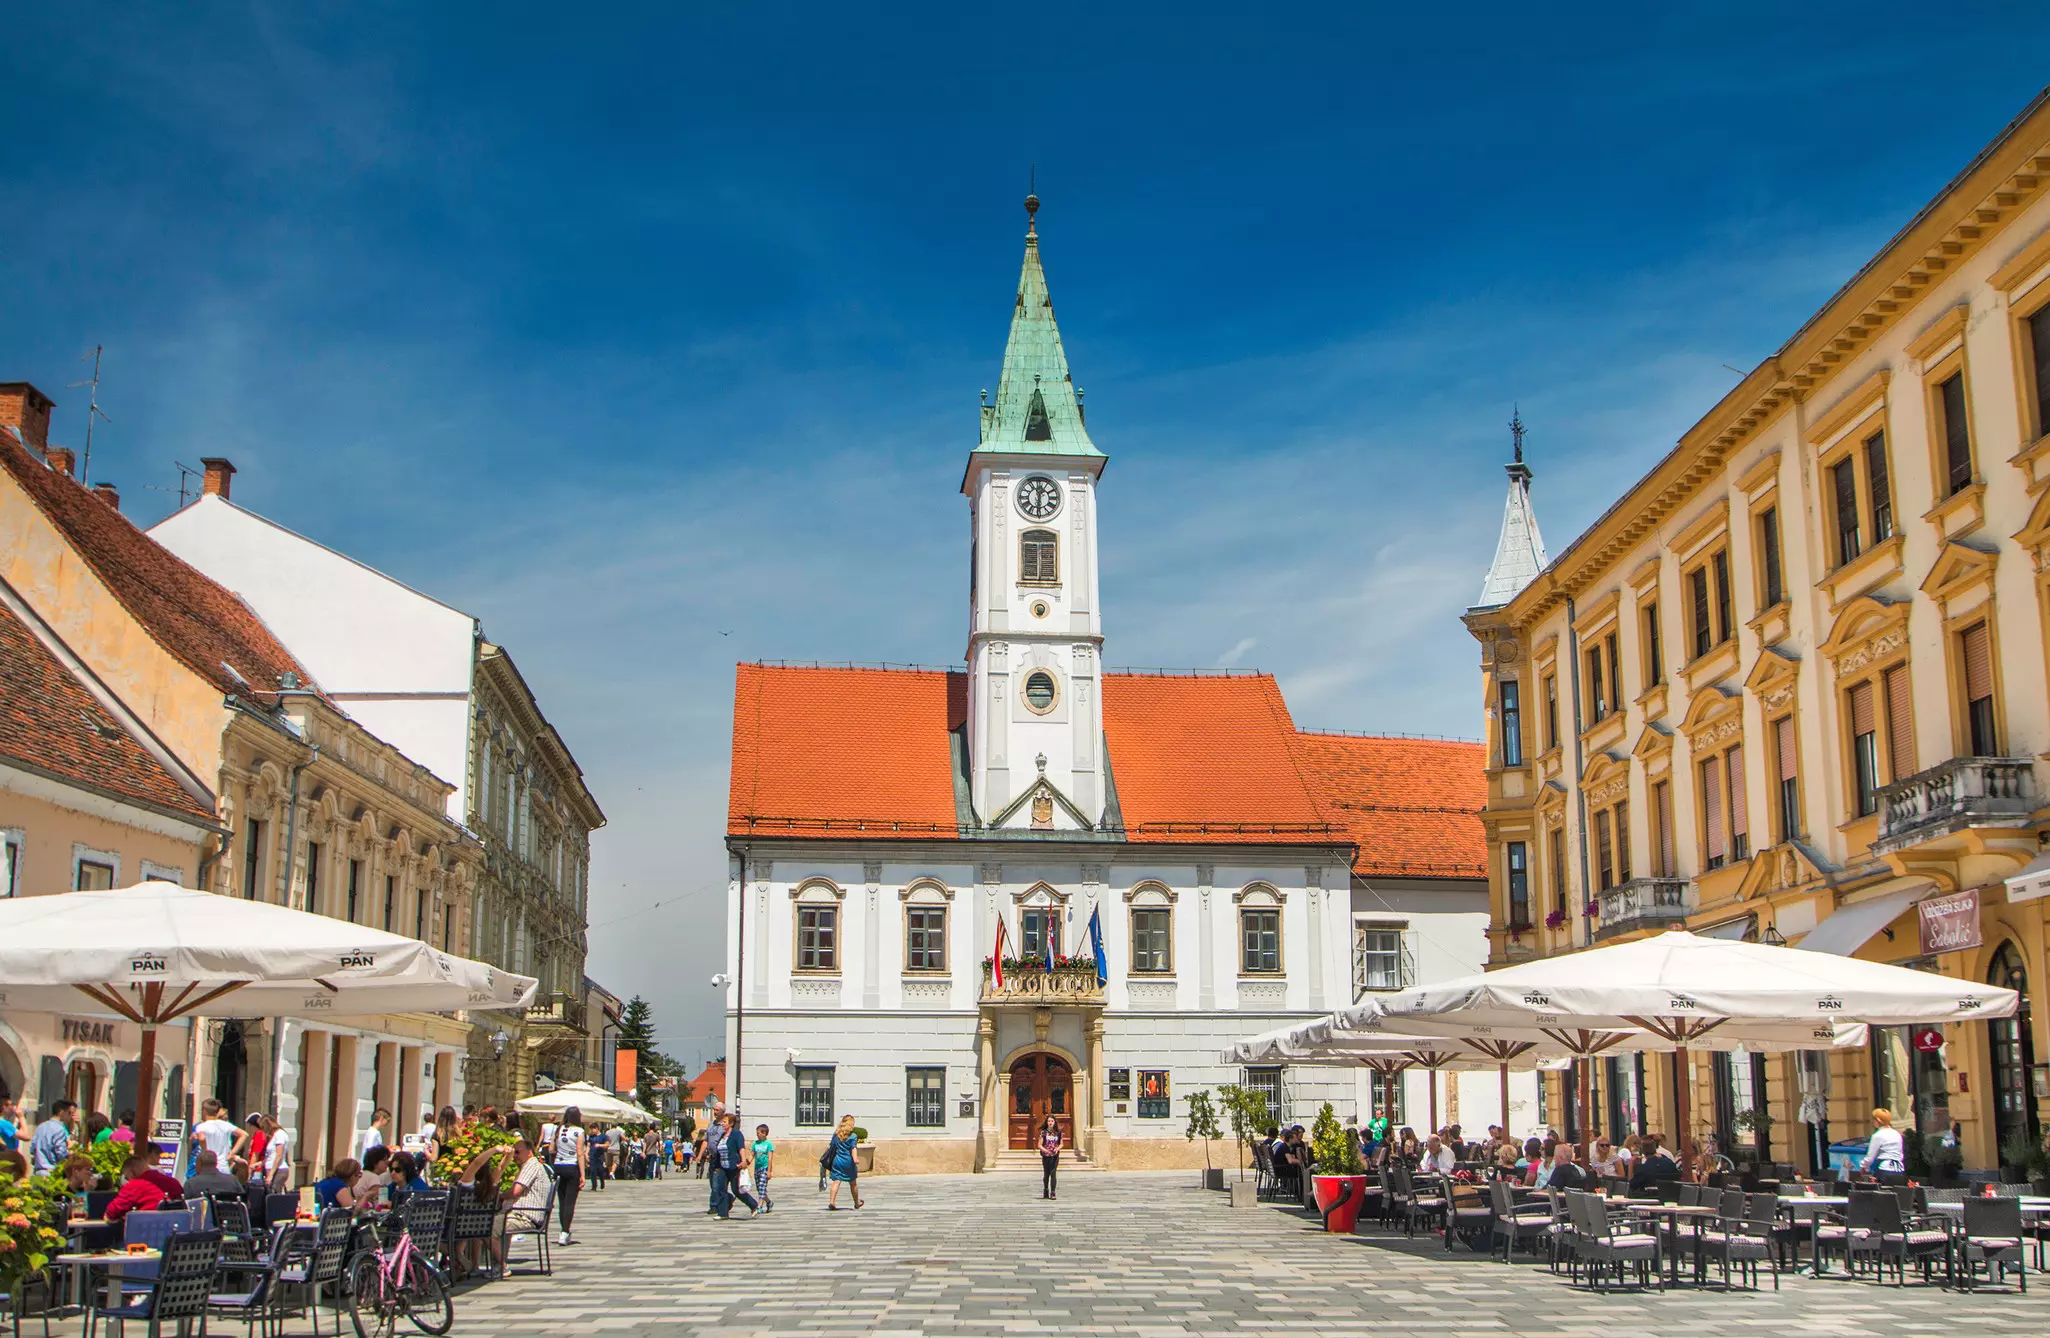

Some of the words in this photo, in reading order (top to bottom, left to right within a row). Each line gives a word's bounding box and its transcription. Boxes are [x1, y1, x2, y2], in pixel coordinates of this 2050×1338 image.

[340, 956, 375, 967] PAN
[132, 961, 166, 972] PAN
[1524, 996, 1549, 1005] PAN
[1671, 1000, 1695, 1009] PAN
[1818, 1000, 1842, 1009] PAN
[1958, 1000, 1981, 1009] PAN
[62, 1019, 115, 1045] TISAK
